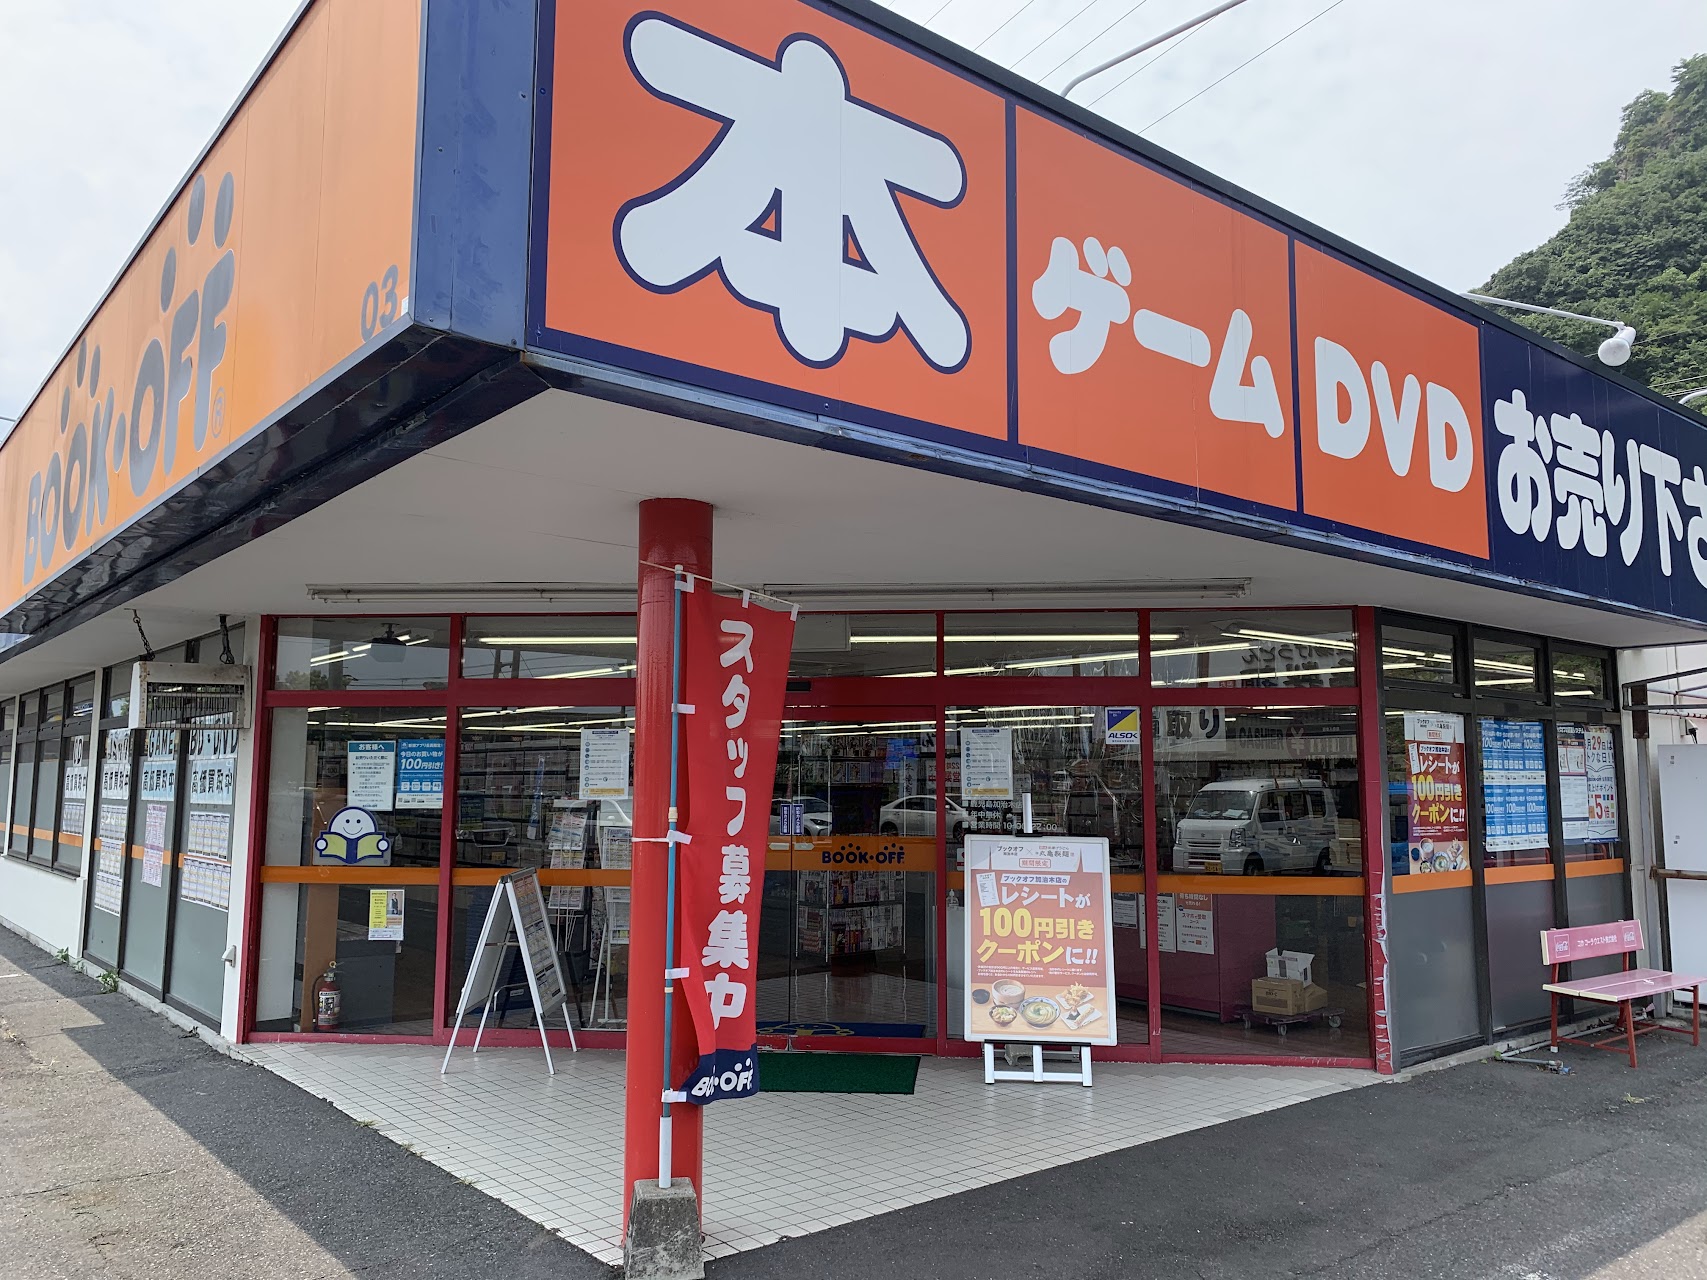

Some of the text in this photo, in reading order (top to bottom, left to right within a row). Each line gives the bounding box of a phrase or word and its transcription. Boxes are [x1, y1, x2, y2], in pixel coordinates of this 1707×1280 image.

[614, 12, 970, 372] 本
[360, 265, 398, 343] 03
[1031, 236, 1285, 438] ゲーム
[1314, 336, 1474, 492] DVD
[358, 743, 385, 751] お客様へ
[1239, 727, 1284, 749] CASHIER
[1420, 755, 1460, 775] レシートが
[1411, 775, 1462, 801] 100円引き
[701, 618, 754, 1031] スタッフ募集中
[1411, 803, 1465, 824] クーポンに!!
[1003, 875, 1067, 883] ブックオフ加治木店の
[1002, 886, 1091, 908] レシートが
[979, 907, 1095, 940] 100円引き
[976, 939, 1099, 965] クーポンに!!
